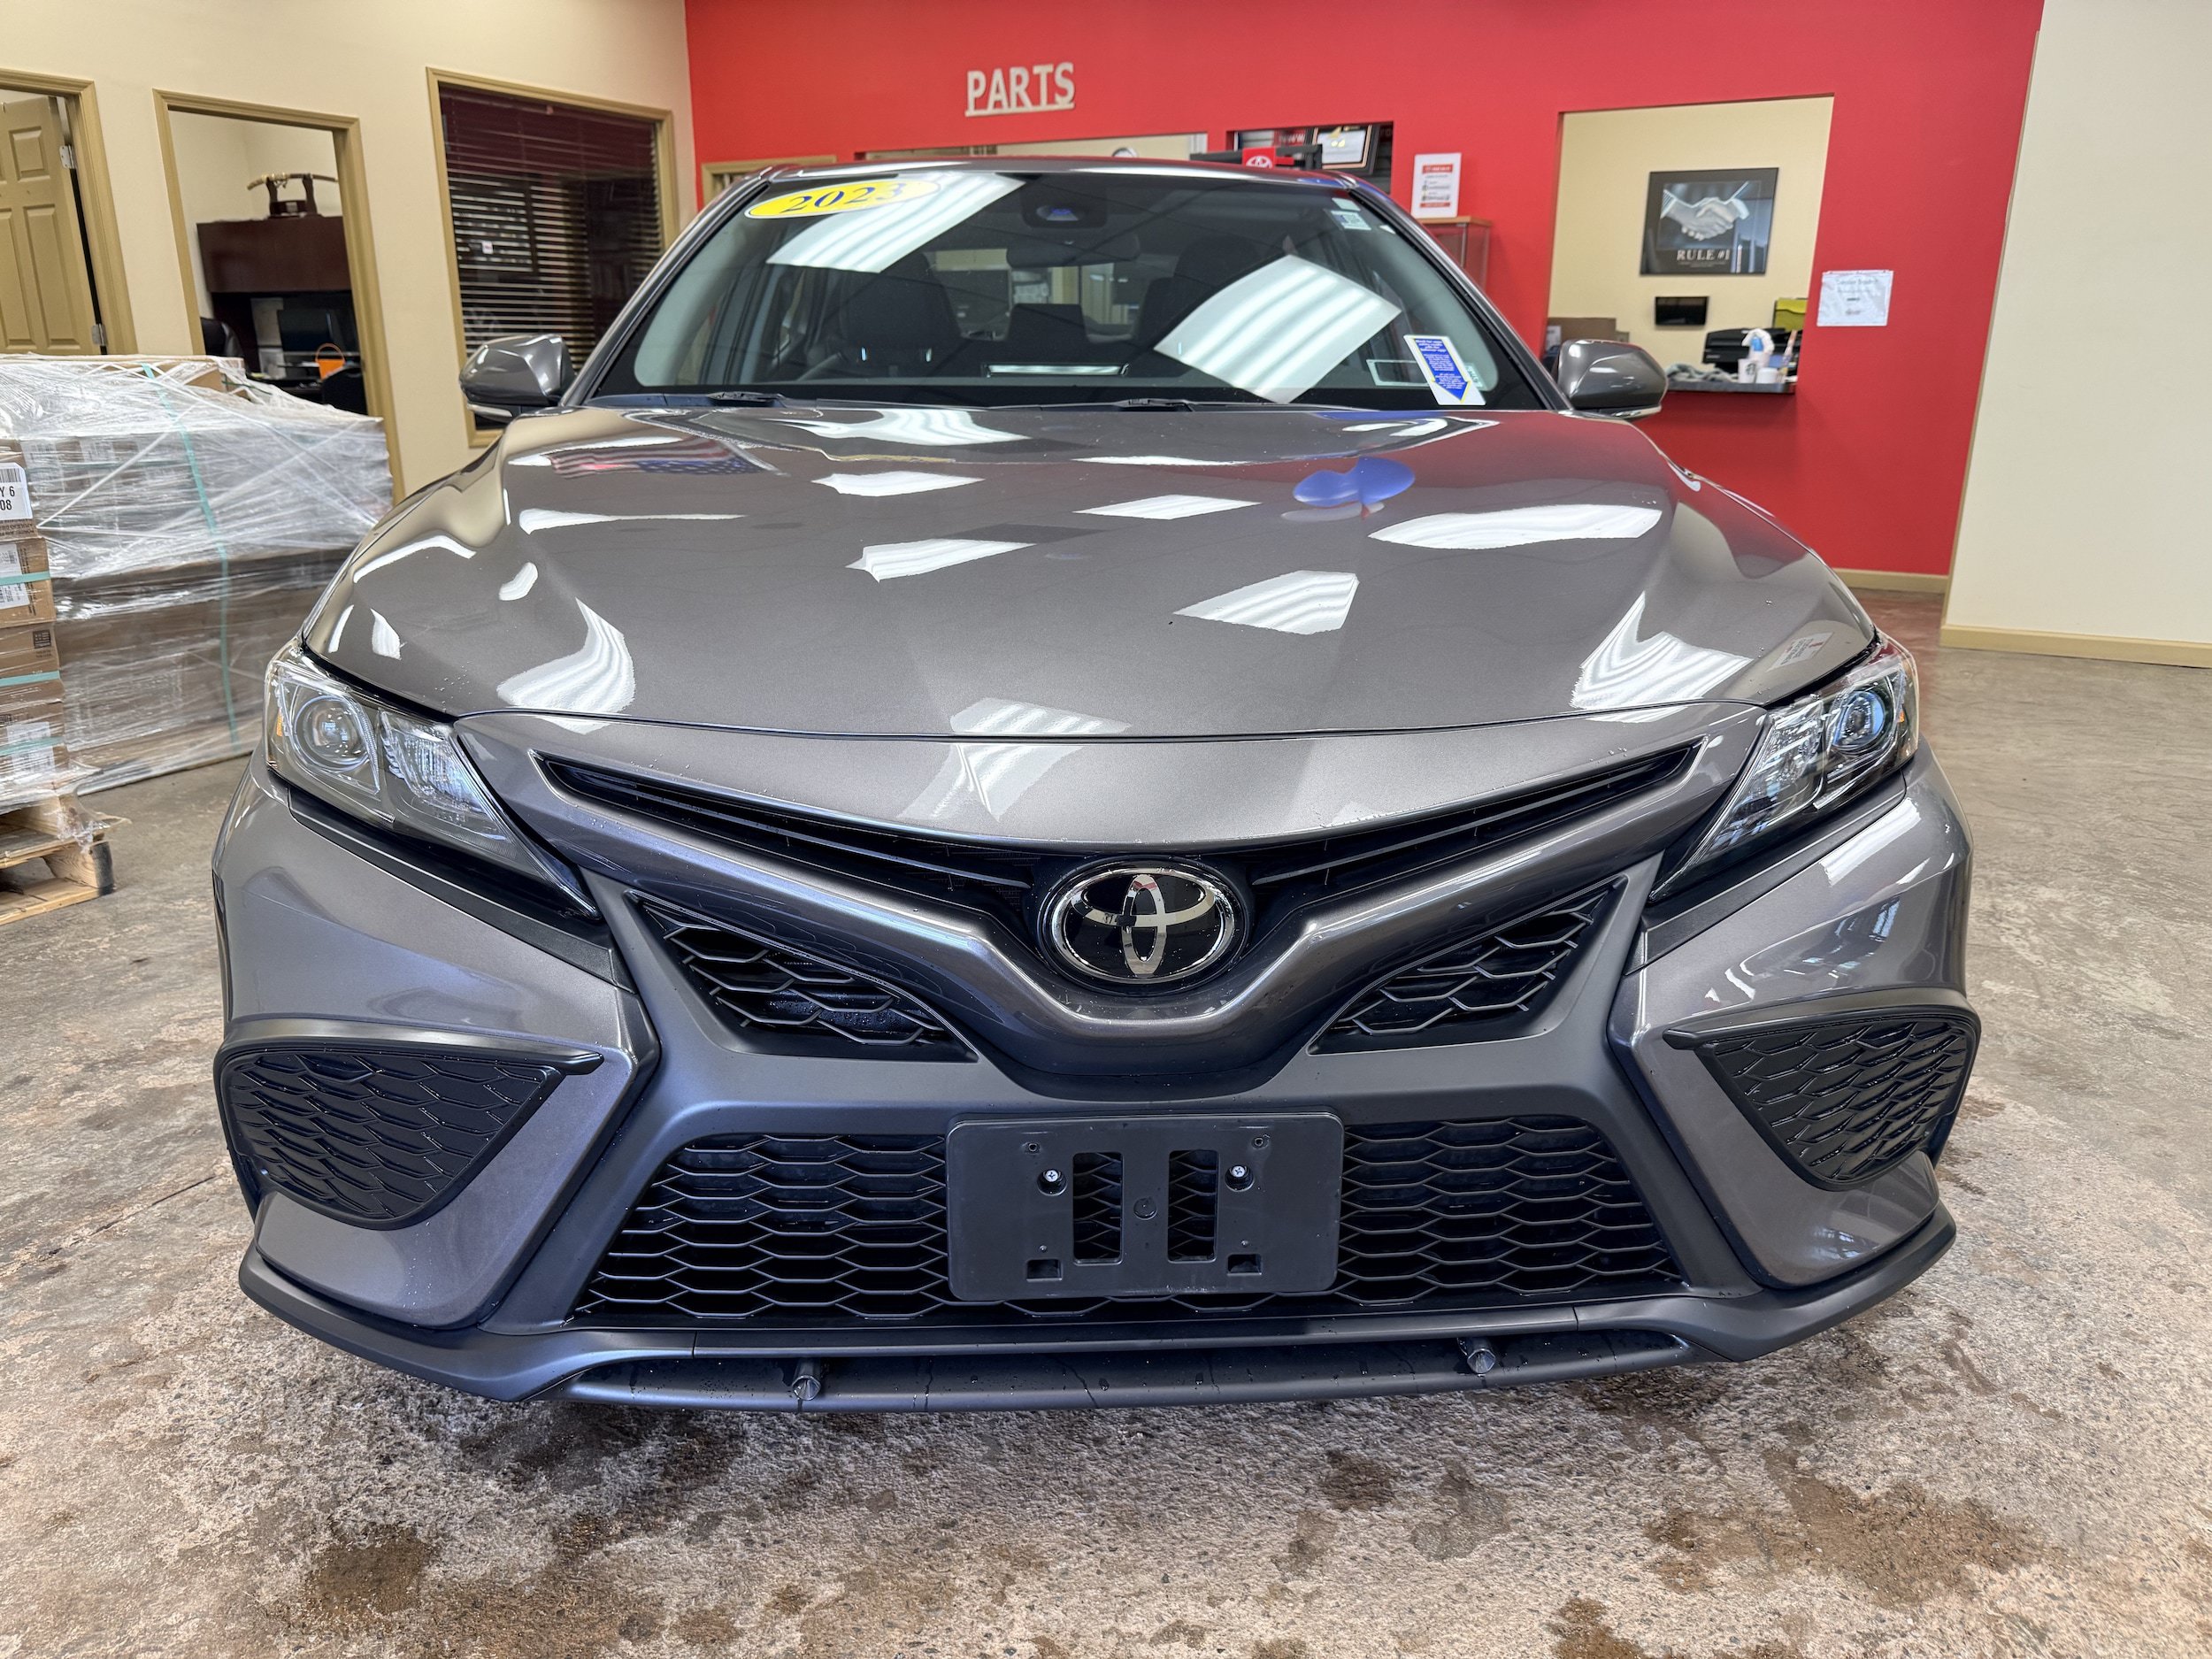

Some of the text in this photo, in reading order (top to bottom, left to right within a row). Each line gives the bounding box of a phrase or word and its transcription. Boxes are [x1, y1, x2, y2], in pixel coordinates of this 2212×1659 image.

[966, 62, 1075, 114] PARTS
[780, 182, 908, 214] 2023
[1677, 249, 1731, 261] RULE #1
[9, 486, 15, 497] 6
